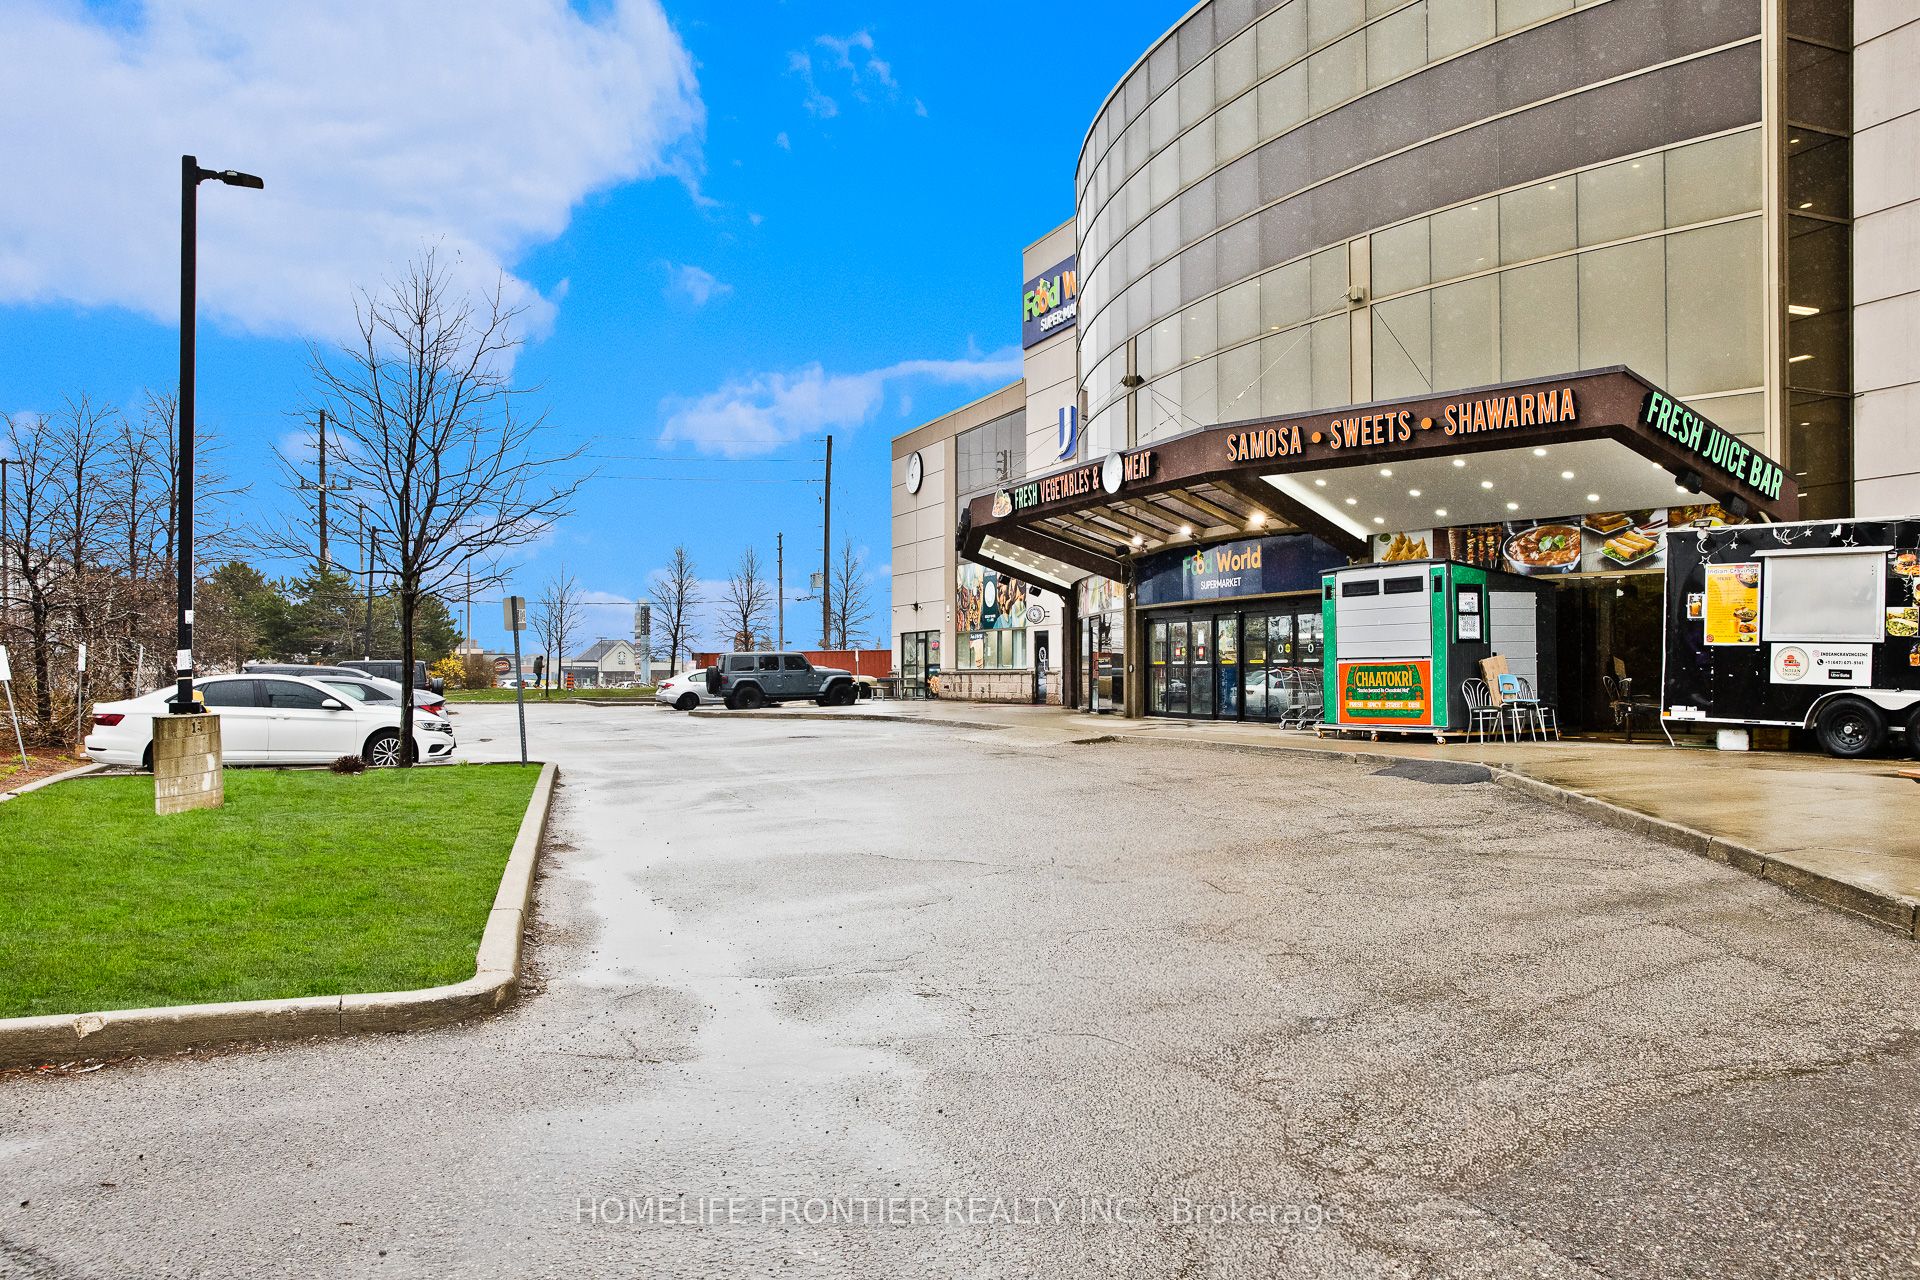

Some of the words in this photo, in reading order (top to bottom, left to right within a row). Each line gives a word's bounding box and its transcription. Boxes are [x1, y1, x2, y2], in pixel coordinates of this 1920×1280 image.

[1024, 275, 1060, 322] Food
[1226, 425, 1303, 462] SAMOSA
[1329, 410, 1411, 450] SWEETS
[1443, 387, 1576, 437] SHAWARMA
[1646, 391, 1705, 452] FRESH
[1702, 428, 1750, 480] JUICE
[1748, 454, 1784, 501] BAR
[1014, 483, 1038, 510] FRESH
[1040, 468, 1090, 503] VEGETABLES
[1092, 466, 1099, 490] &
[1124, 451, 1151, 482] MEAT
[1183, 551, 1213, 576] Food
[1216, 544, 1262, 573] World
[1200, 577, 1241, 590] SUPERMARKET
[1355, 671, 1413, 687] CHAATOKRI
